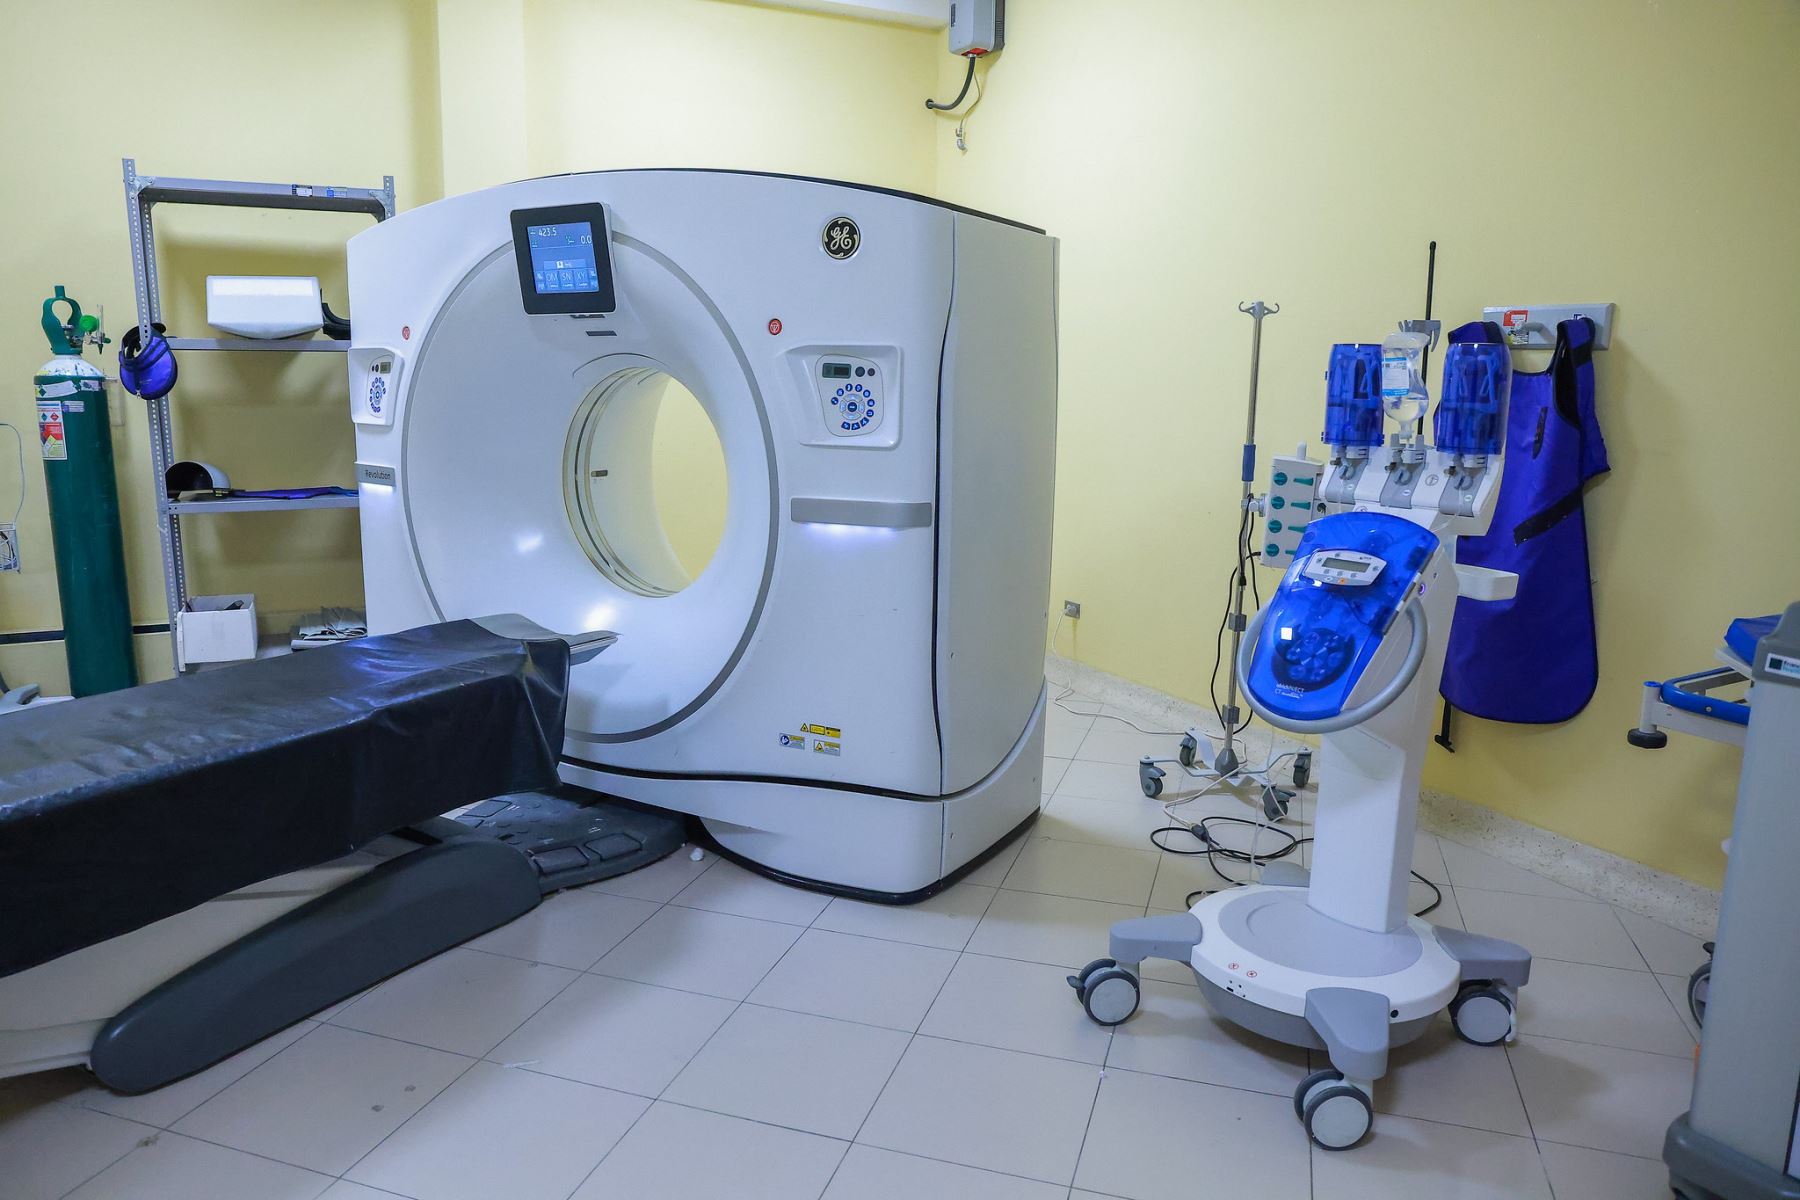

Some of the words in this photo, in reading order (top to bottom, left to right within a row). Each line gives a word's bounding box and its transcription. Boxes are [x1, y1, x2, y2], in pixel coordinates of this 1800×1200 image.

[538, 227, 557, 237] 423.5
[580, 235, 592, 245] 0.0
[830, 226, 852, 250] GE
[365, 469, 391, 480] Revolution
